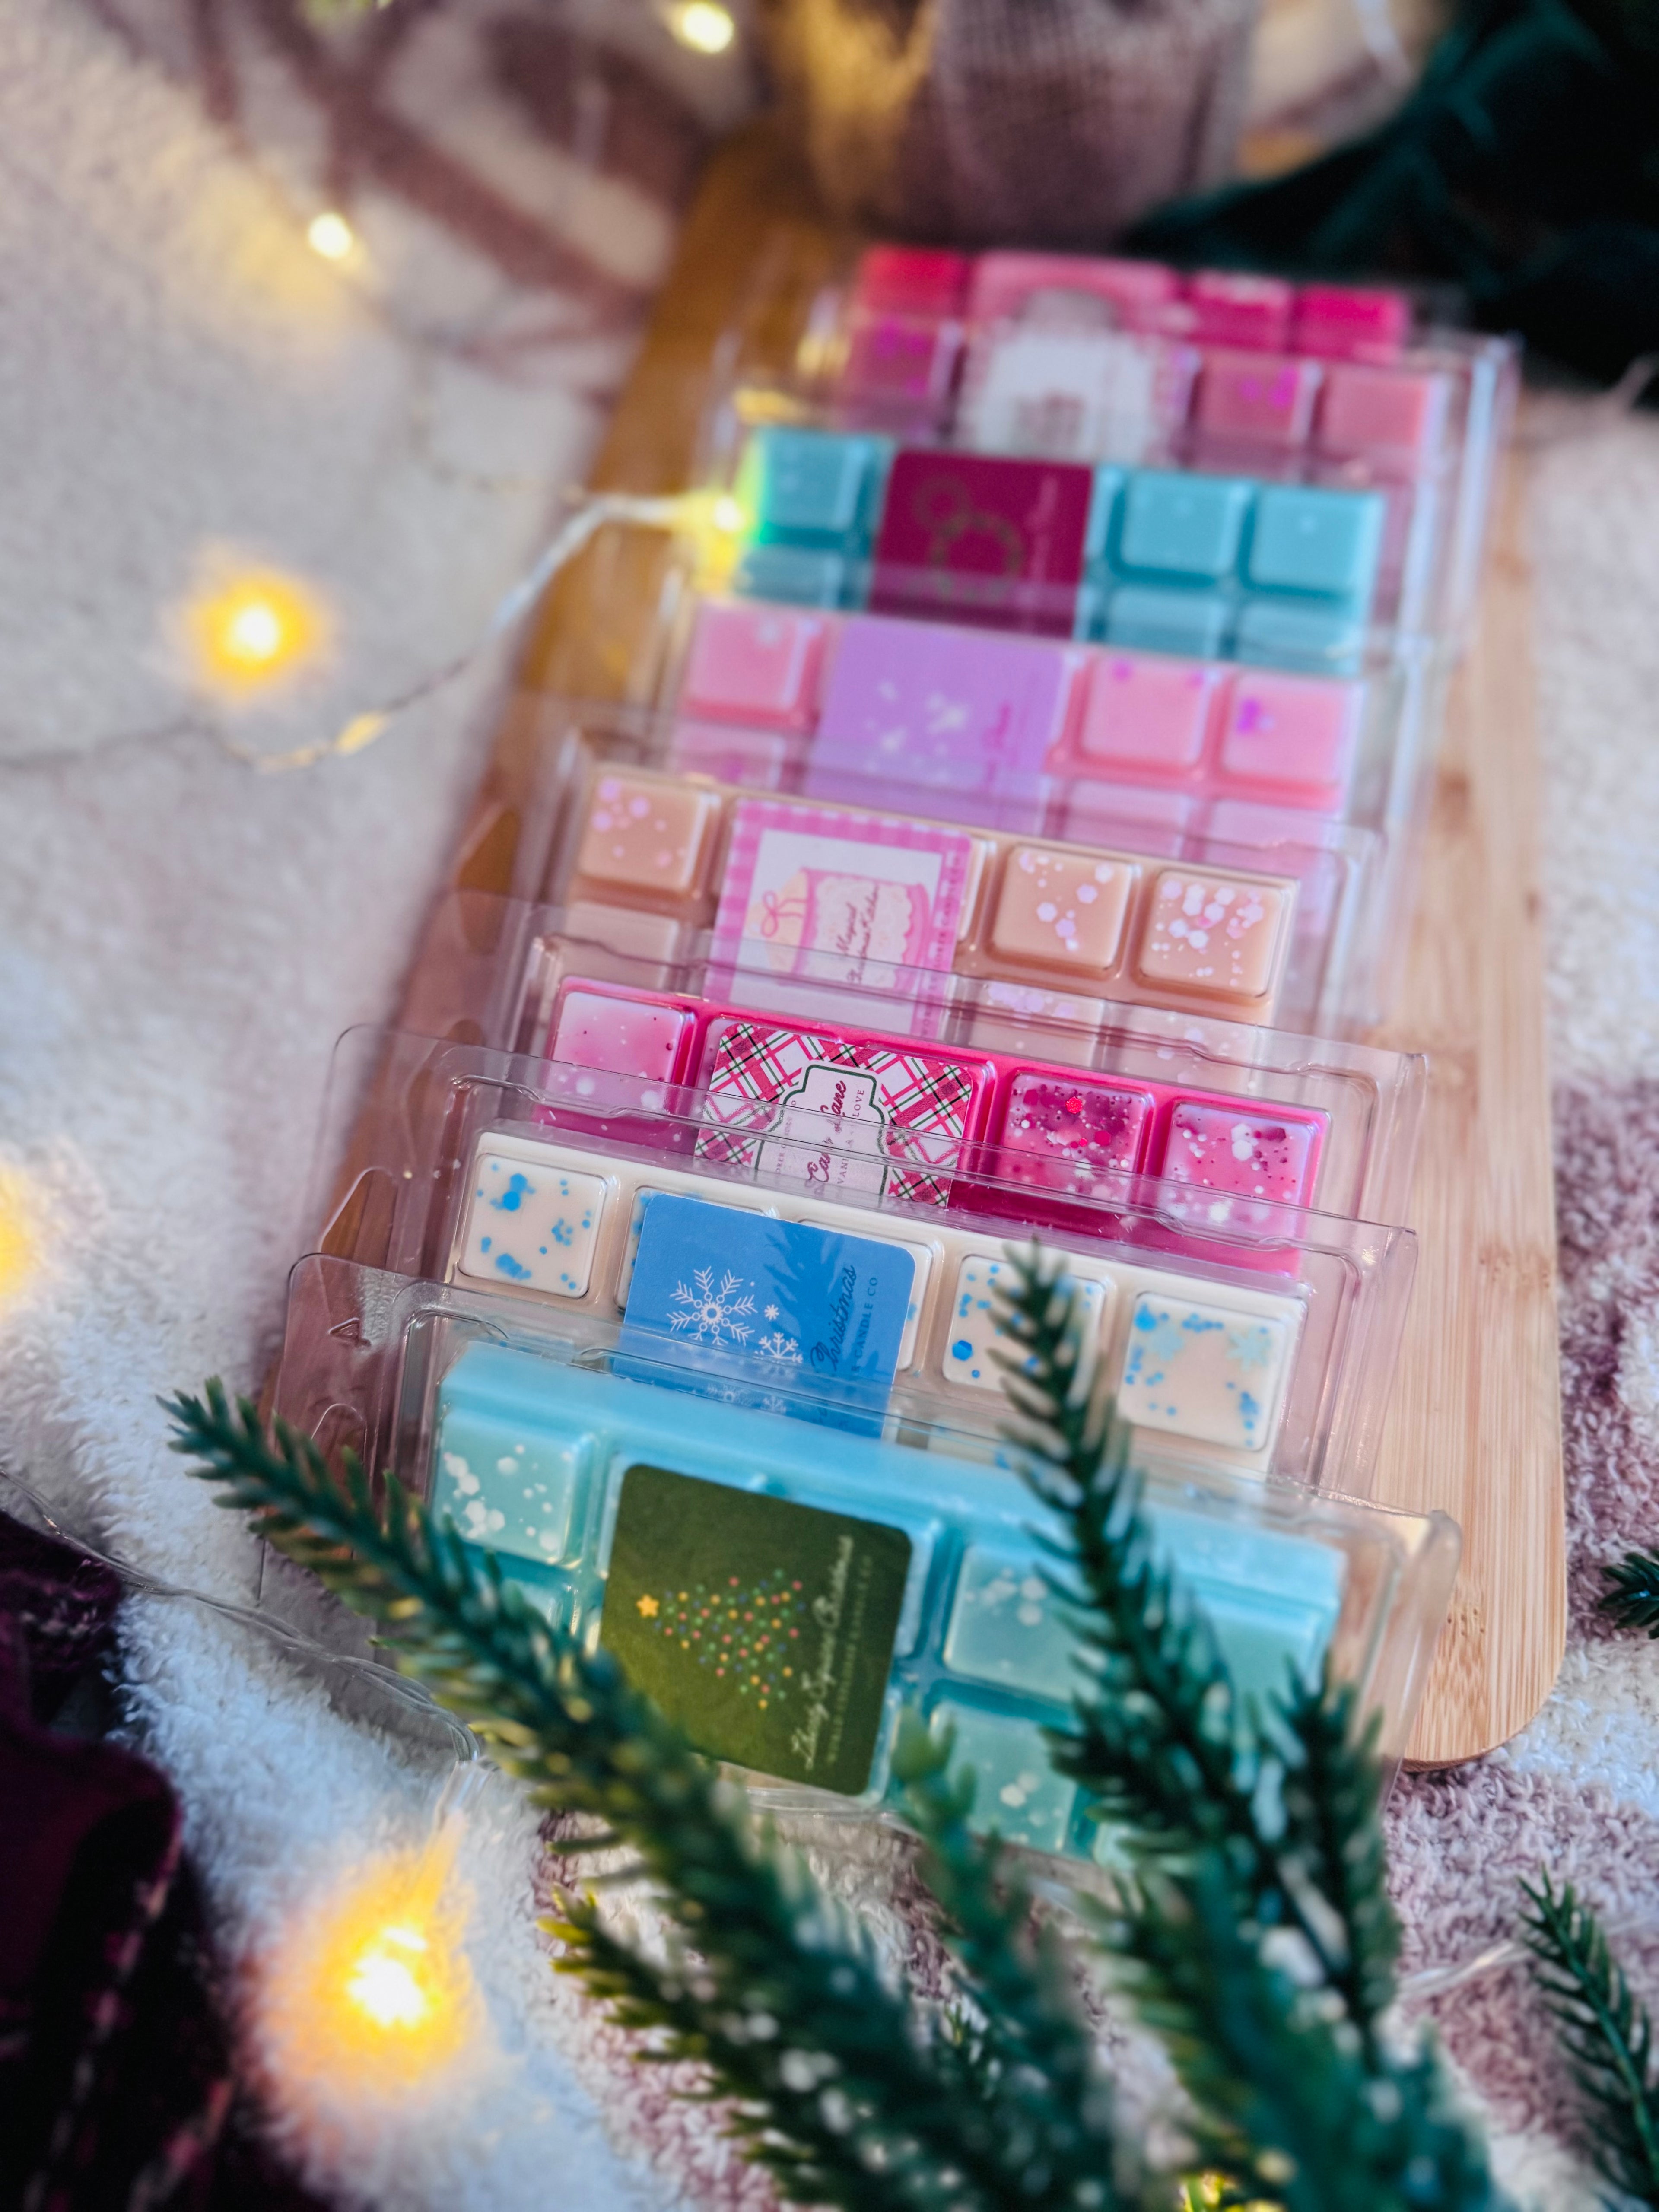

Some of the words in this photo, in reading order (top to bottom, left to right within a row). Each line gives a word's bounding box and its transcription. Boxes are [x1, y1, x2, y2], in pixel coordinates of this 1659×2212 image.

[810, 1265, 856, 1372] Christmas
[855, 1303, 873, 1359] CANDLE
[868, 1277, 878, 1297] CO
